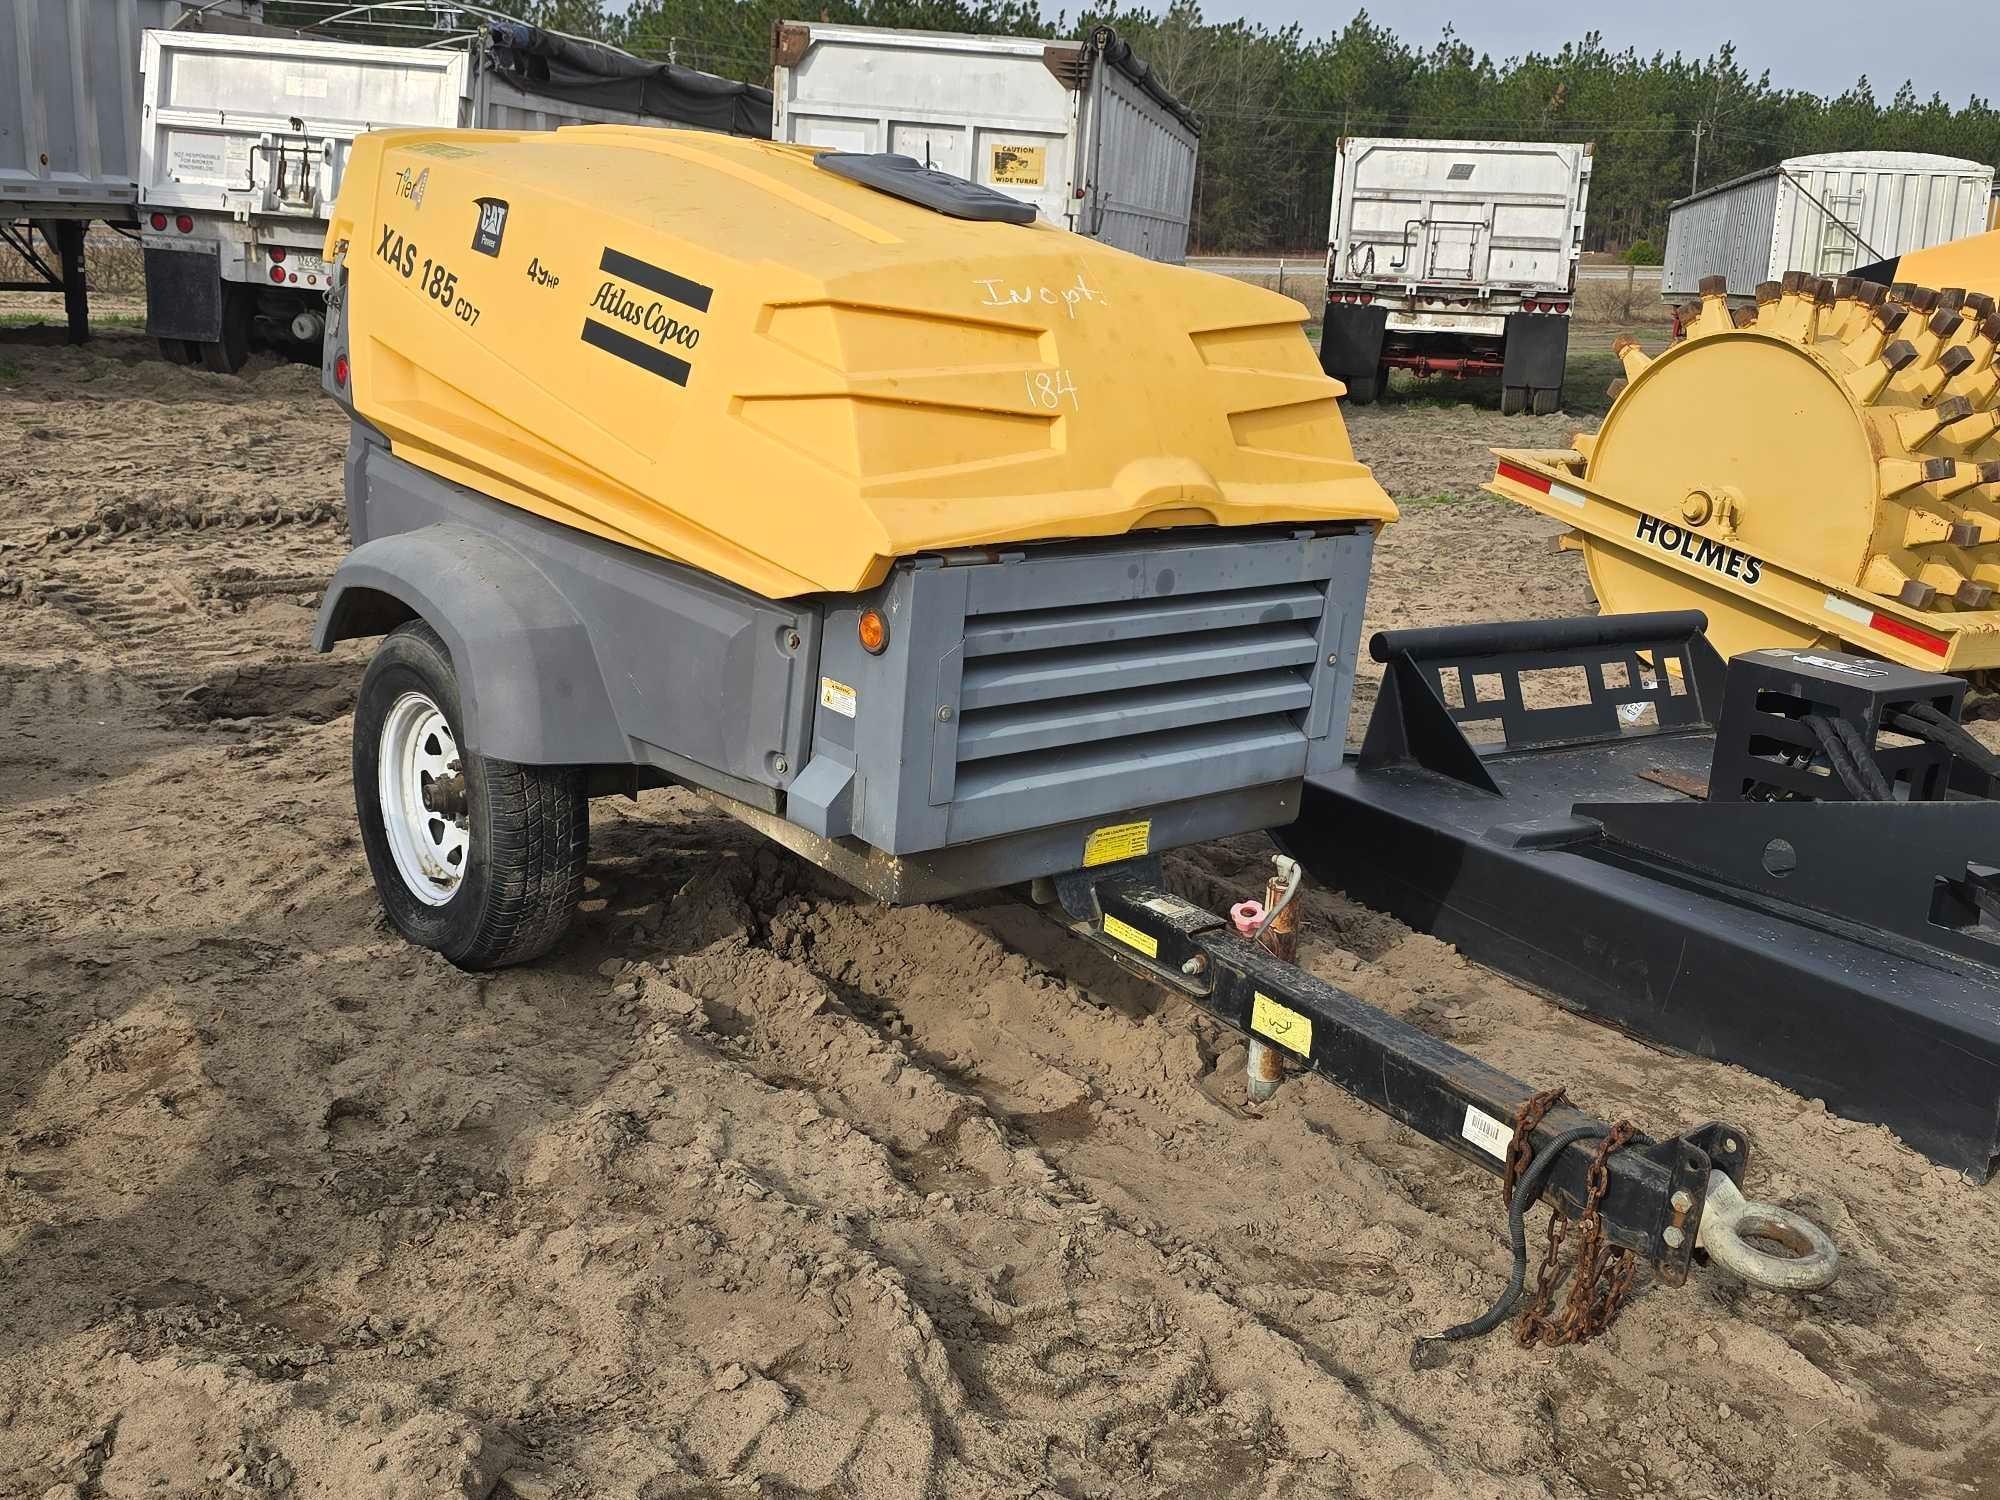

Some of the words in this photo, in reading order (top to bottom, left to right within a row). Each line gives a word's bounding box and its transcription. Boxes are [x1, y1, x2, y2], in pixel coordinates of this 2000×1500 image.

[1002, 146, 1034, 154] CAUTION
[481, 202, 507, 236] CAT
[376, 223, 417, 279] XAS
[420, 258, 459, 308] 185
[454, 297, 481, 327] CD7
[1024, 368, 1079, 413] 184
[1635, 512, 1764, 586] HOLMES
